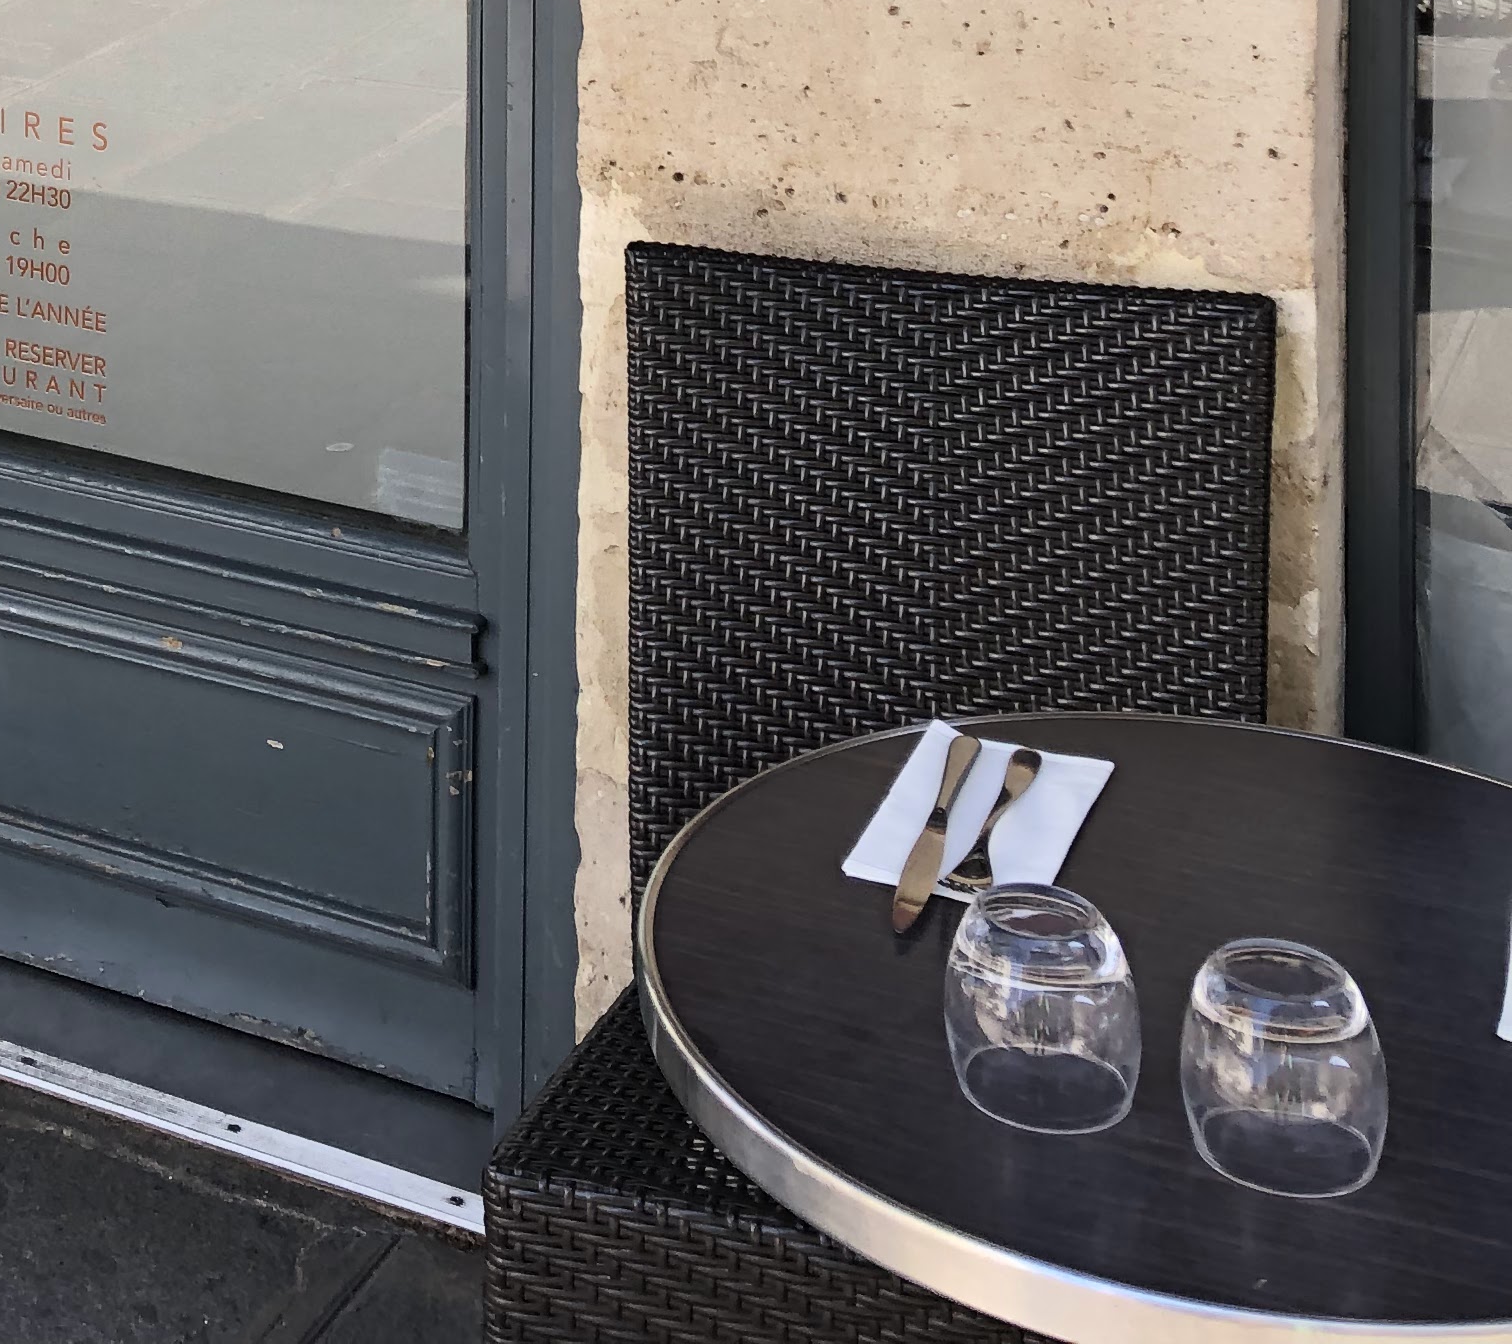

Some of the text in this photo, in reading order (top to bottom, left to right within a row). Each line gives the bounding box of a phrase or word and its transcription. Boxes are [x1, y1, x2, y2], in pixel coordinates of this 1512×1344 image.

[6, 180, 71, 210] 22H30
[6, 255, 71, 286] 19H00
[5, 338, 107, 378] RESERVER
